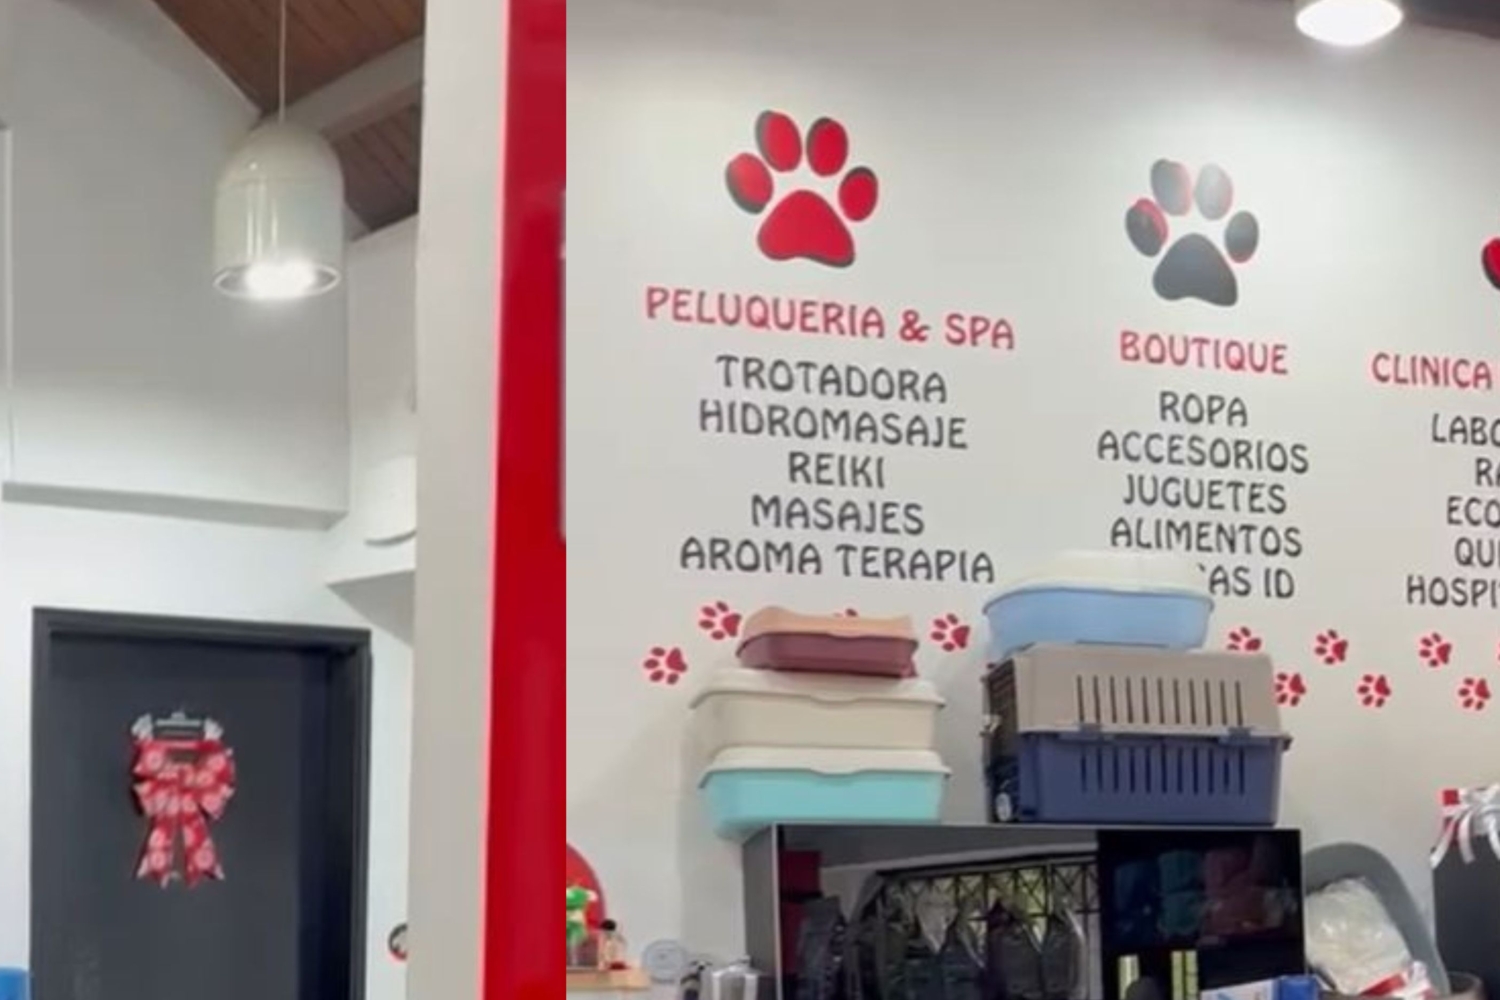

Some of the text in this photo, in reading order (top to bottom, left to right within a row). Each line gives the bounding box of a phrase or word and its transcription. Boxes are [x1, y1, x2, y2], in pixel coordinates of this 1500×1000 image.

[646, 286, 1015, 350] PELUQUERIA & SPA
[1120, 330, 1288, 375] BOUTIQUE
[1372, 352, 1492, 390] CLINICA
[716, 354, 948, 403] TROTADORA
[700, 399, 968, 449] HIDROMASAJE
[1159, 390, 1248, 428] ROPA
[789, 451, 885, 488] REIKI
[1097, 430, 1309, 475] ACCESORIOS
[1475, 457, 1500, 487] R
[1122, 473, 1287, 515] JUGUETES
[1447, 495, 1500, 529] ECO
[751, 494, 925, 536] MASAJES
[1110, 517, 1303, 558] ALIMENTOS
[680, 537, 996, 584] AROMA TERAPIA
[1197, 563, 1296, 600] AS ID
[1406, 574, 1500, 609] HOSPI
